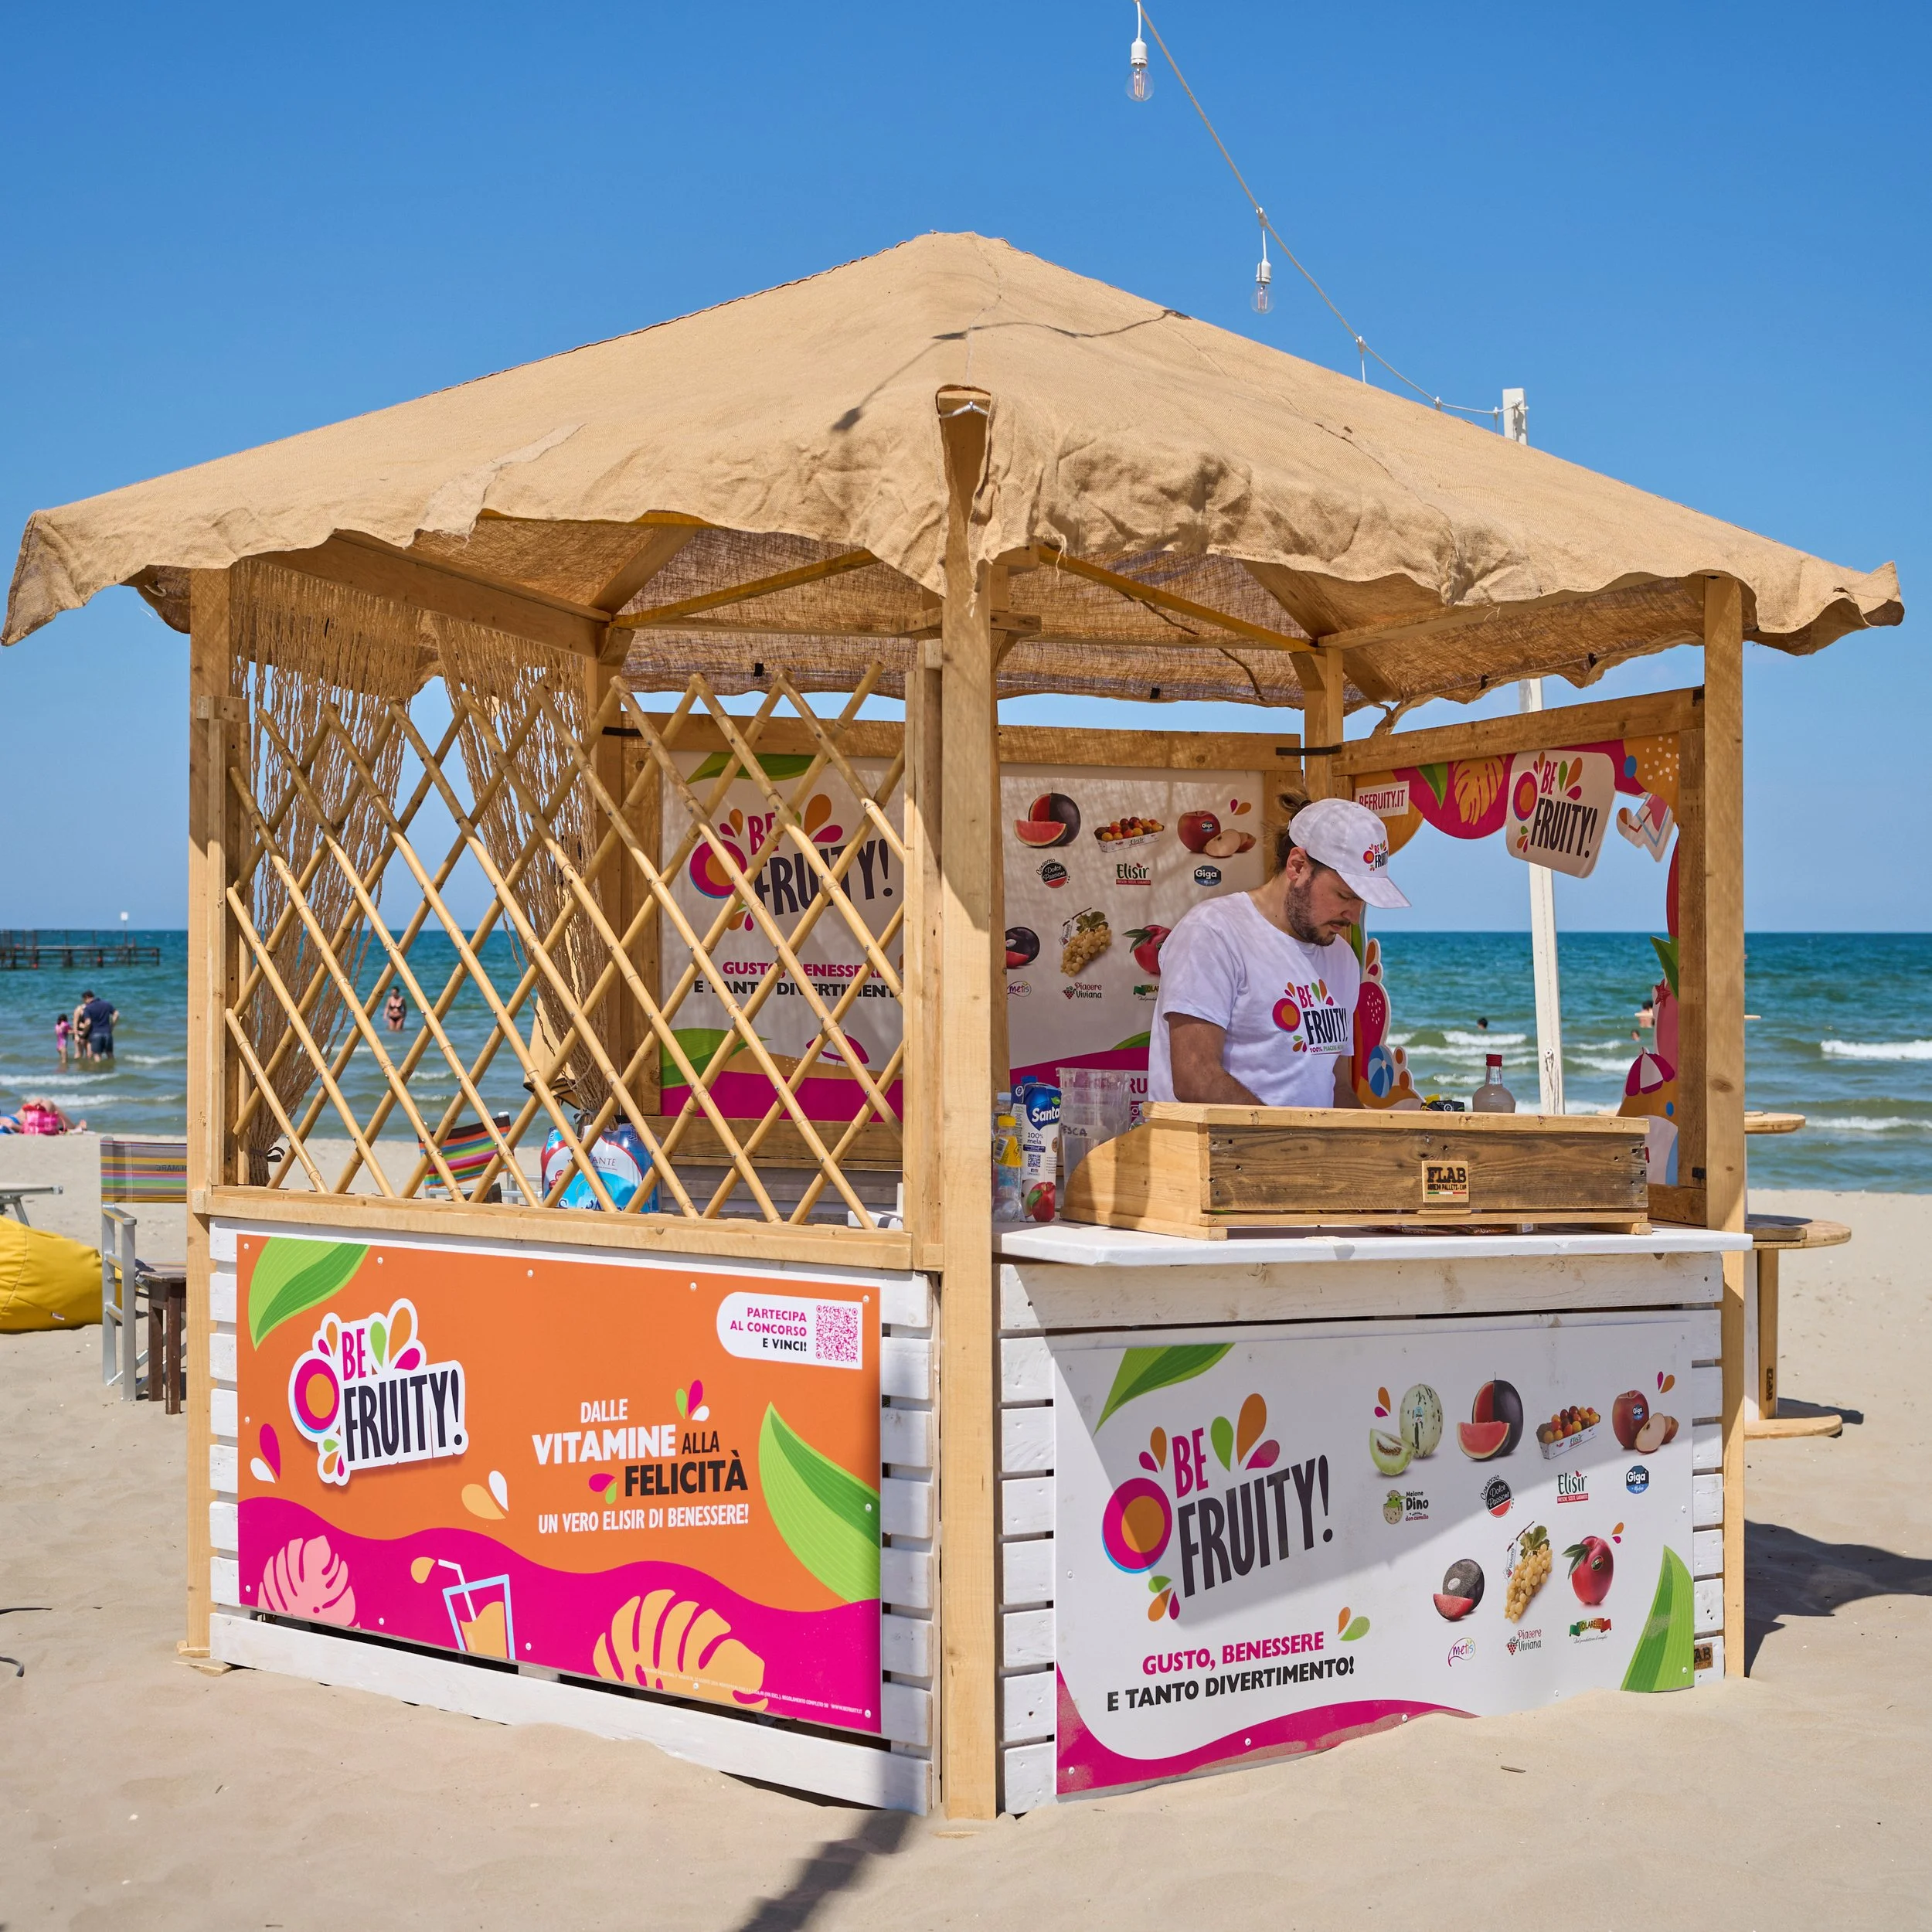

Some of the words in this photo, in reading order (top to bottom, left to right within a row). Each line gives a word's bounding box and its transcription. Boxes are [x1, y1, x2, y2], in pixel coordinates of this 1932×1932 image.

[1540, 760, 1557, 796] BE
[1530, 796, 1597, 859] FRUITY!
[1375, 845, 1379, 854] BE
[1116, 863, 1150, 879] Elisir
[1196, 869, 1217, 879] Giga
[694, 981, 703, 993] E
[1076, 989, 1102, 998] Viviana
[1296, 985, 1314, 1009] BE
[1303, 1008, 1348, 1045] FRUITY!
[1427, 1167, 1467, 1183] FLAB
[747, 1307, 807, 1322] PARTECIPA
[730, 1320, 743, 1331] AL
[747, 1322, 807, 1337] CONCORSO
[342, 1328, 367, 1381] BE
[763, 1338, 769, 1348] E
[772, 1338, 807, 1352] VINCI!
[344, 1369, 463, 1462] FRUITY!
[580, 1398, 628, 1423] DALLE
[532, 1423, 676, 1465] VITAMINE
[682, 1430, 719, 1454] ALLA
[1172, 1427, 1209, 1499] BE
[625, 1449, 748, 1497] FELICITÀ
[1627, 1471, 1646, 1484] Giga
[1490, 1485, 1506, 1497] Dolce
[1558, 1473, 1587, 1495] Elisir
[1406, 1497, 1429, 1511] Dino
[539, 1514, 558, 1533] UN
[562, 1512, 599, 1532] VERO
[603, 1508, 645, 1530] ELISIR
[648, 1509, 664, 1528] DI
[667, 1503, 749, 1527] BENESSERE!
[1177, 1454, 1332, 1598] FRUITY!
[1518, 1628, 1542, 1640] Piacere
[1142, 1646, 1215, 1675] GUSTO,
[1222, 1631, 1324, 1665] BENESSERE
[1453, 1642, 1474, 1655] metis
[1518, 1639, 1542, 1651] Viviana
[1107, 1691, 1118, 1712] E
[1125, 1679, 1199, 1708] TANTO
[1205, 1655, 1354, 1696] DIVERTIMENTO!
